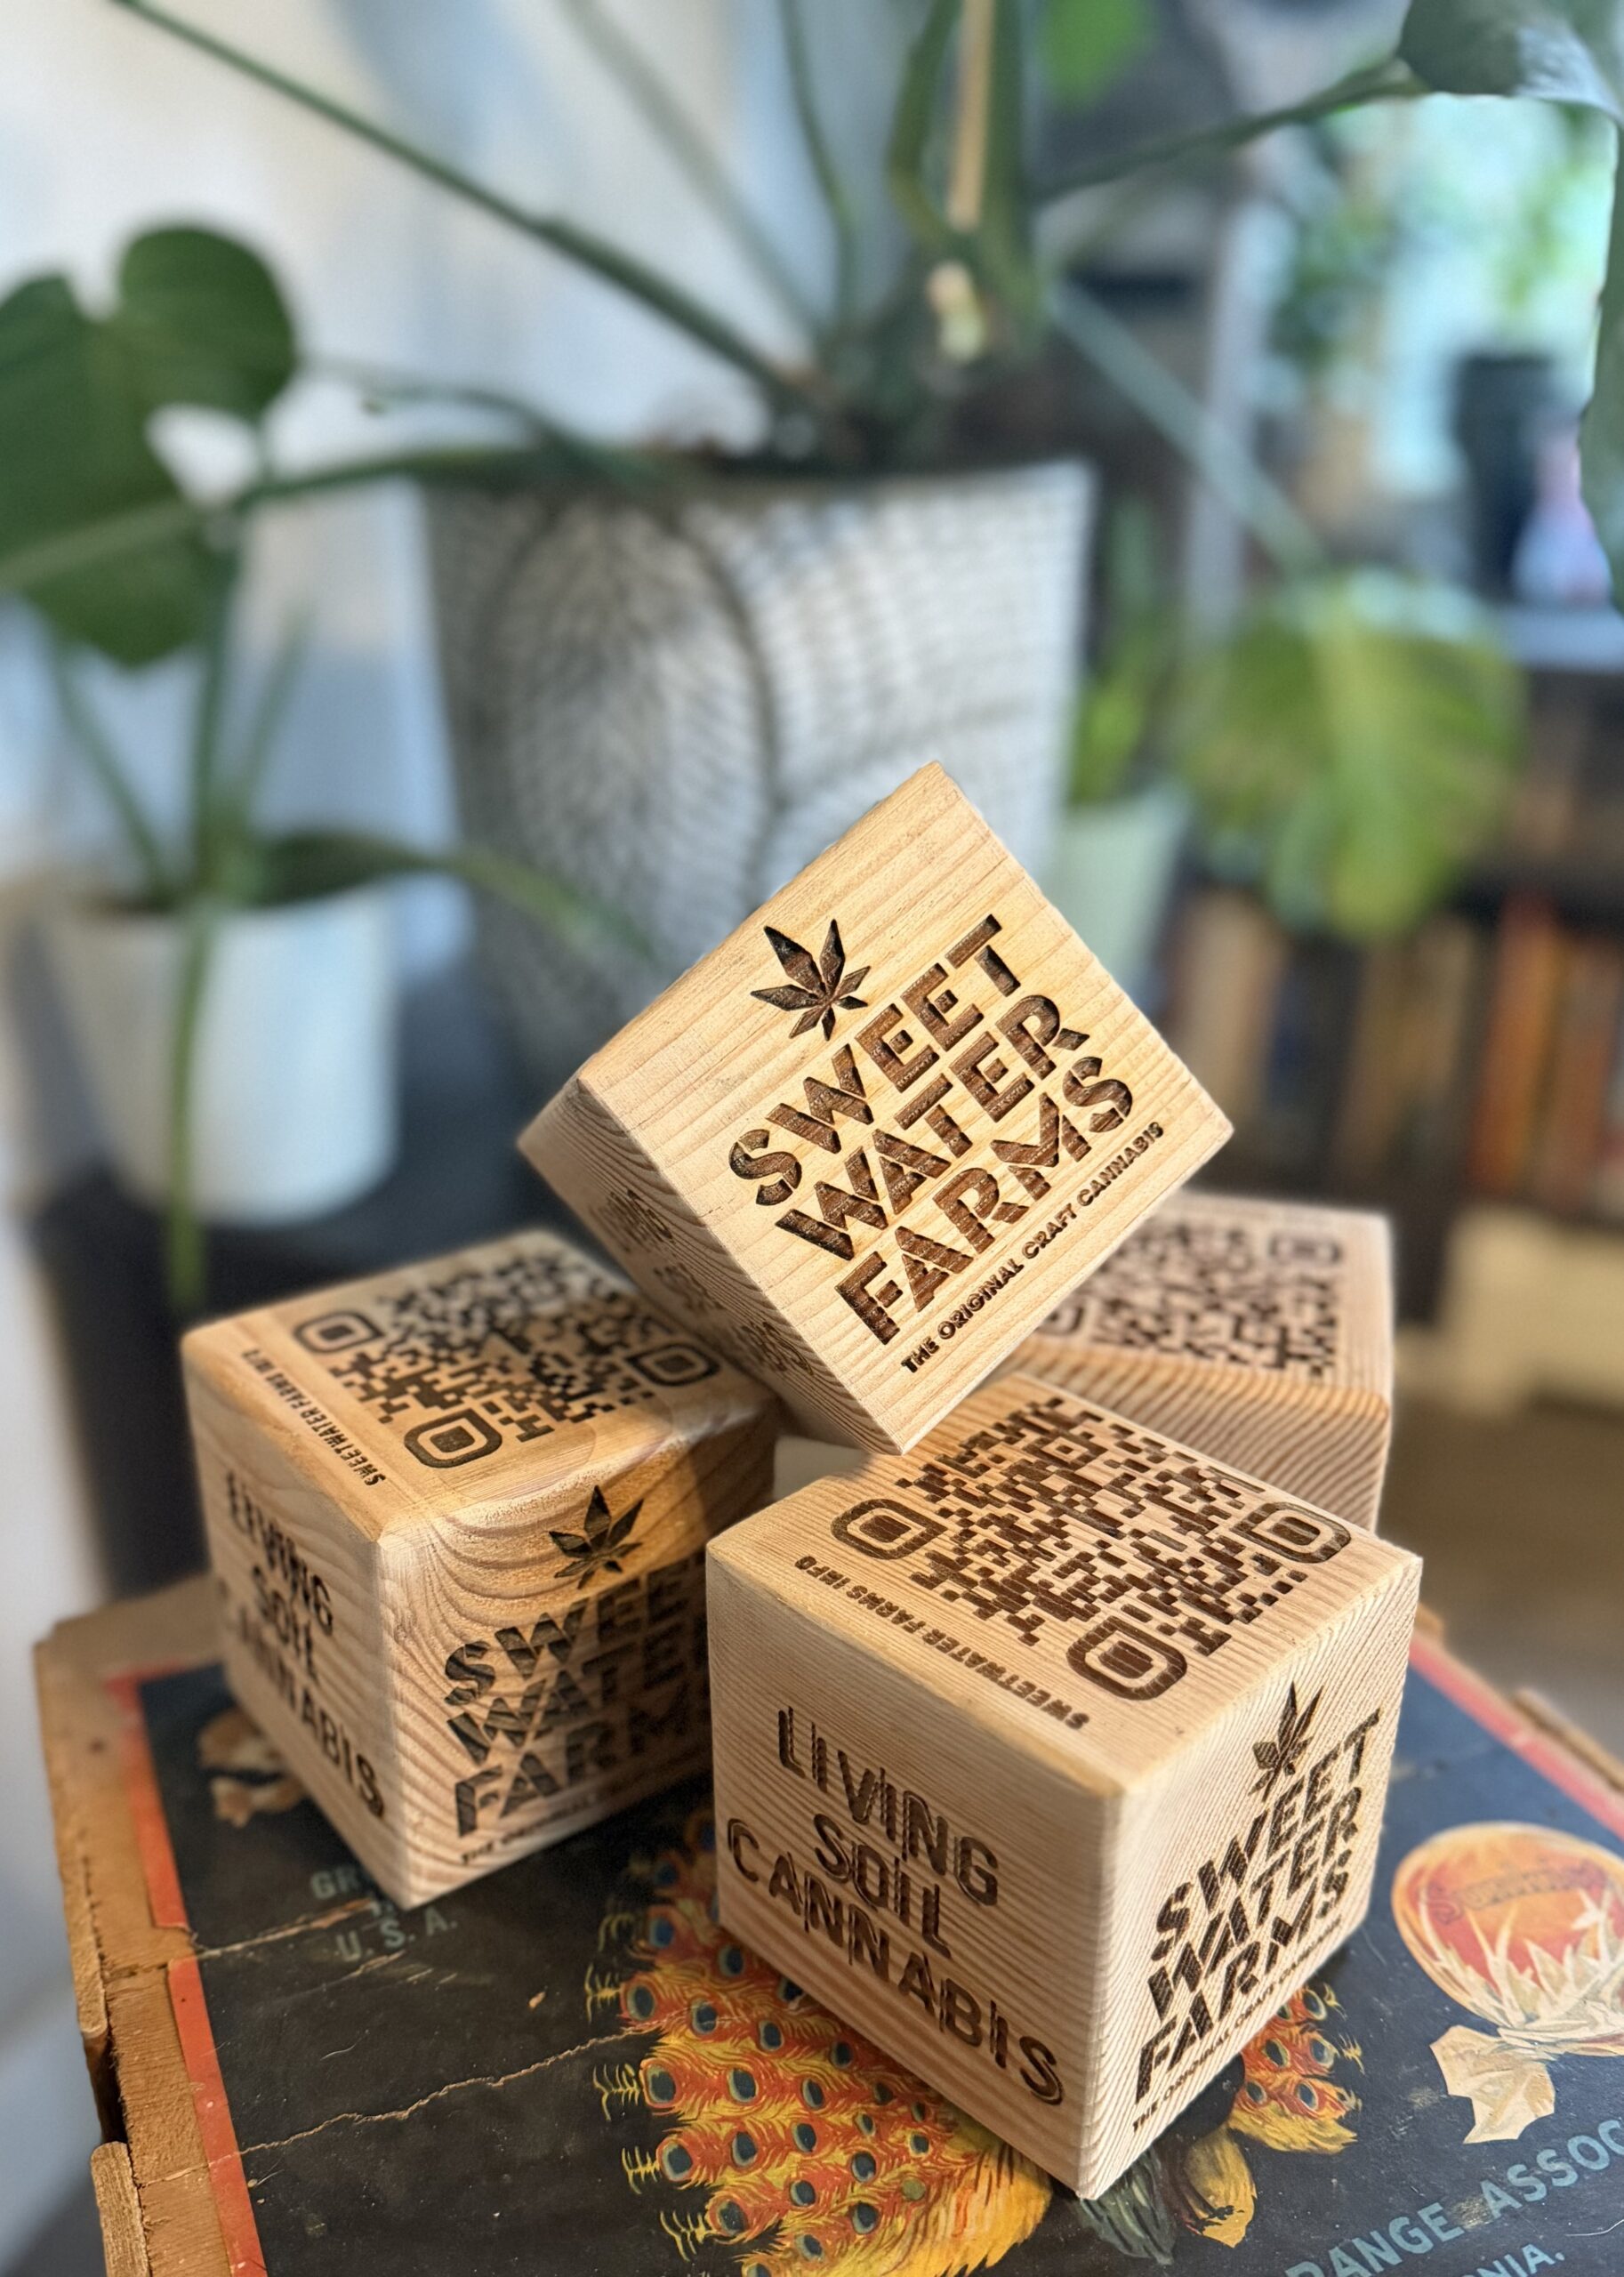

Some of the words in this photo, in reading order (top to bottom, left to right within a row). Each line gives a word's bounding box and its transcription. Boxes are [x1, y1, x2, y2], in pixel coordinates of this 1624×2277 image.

[729, 914, 1020, 1205] SWEET
[776, 994, 1089, 1260] WATER
[835, 1057, 1133, 1345] FARMS
[901, 1335, 938, 1373] THE
[937, 1259, 1024, 1340] ORIGINAL
[1022, 1203, 1077, 1259] CRAFT
[1077, 1121, 1164, 1206] CANNABIS
[301, 1401, 386, 1485] SWEETWATER
[445, 1550, 707, 1705] SWEE
[795, 1557, 849, 1589] INFO
[847, 1585, 926, 1633] FARMS
[455, 1677, 711, 1838] FARM
[922, 1629, 1089, 1729] SWEETWATER
[777, 1706, 998, 1905] LIVING
[815, 1813, 951, 1957] SOIL
[1151, 1708, 1380, 1961] SWEET
[728, 1818, 1064, 2106] CANNABIS
[1136, 1848, 1350, 2104] FARMS
[1147, 1787, 1362, 2021] WATER
[1133, 2100, 1158, 2132] THE
[1461, 2244, 1564, 2277] NIA.
